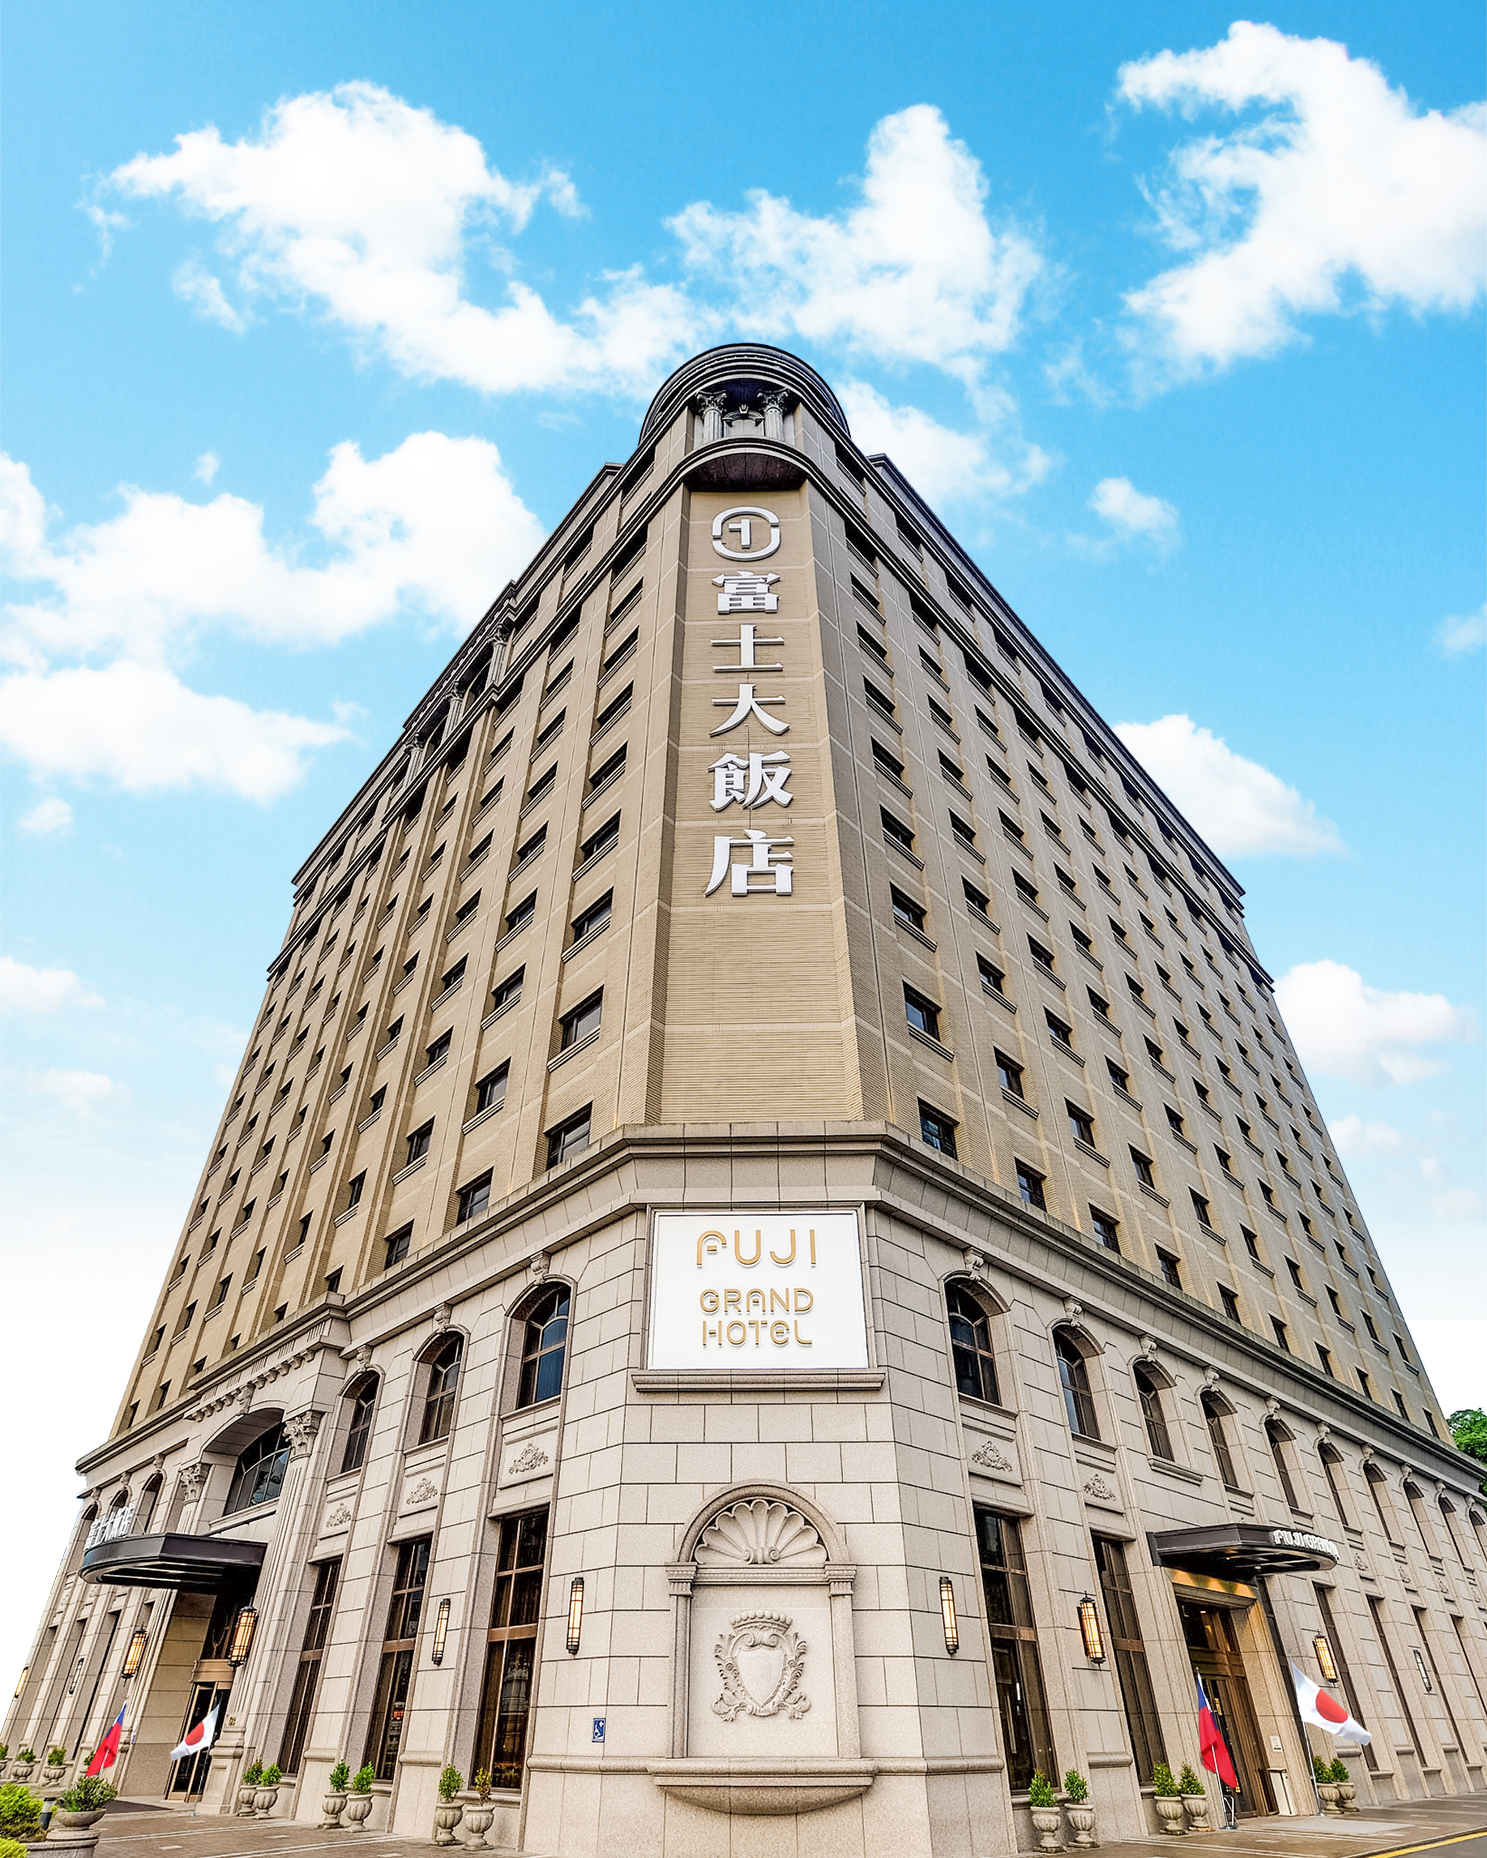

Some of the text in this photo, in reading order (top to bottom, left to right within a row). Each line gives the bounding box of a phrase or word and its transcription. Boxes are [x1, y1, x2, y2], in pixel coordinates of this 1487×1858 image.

[704, 570, 795, 898] 富士大飯店
[696, 1229, 817, 1266] FUJI
[699, 1287, 815, 1314] GRAND
[702, 1319, 813, 1346] HOTEL
[1273, 1529, 1305, 1548] FUJI
